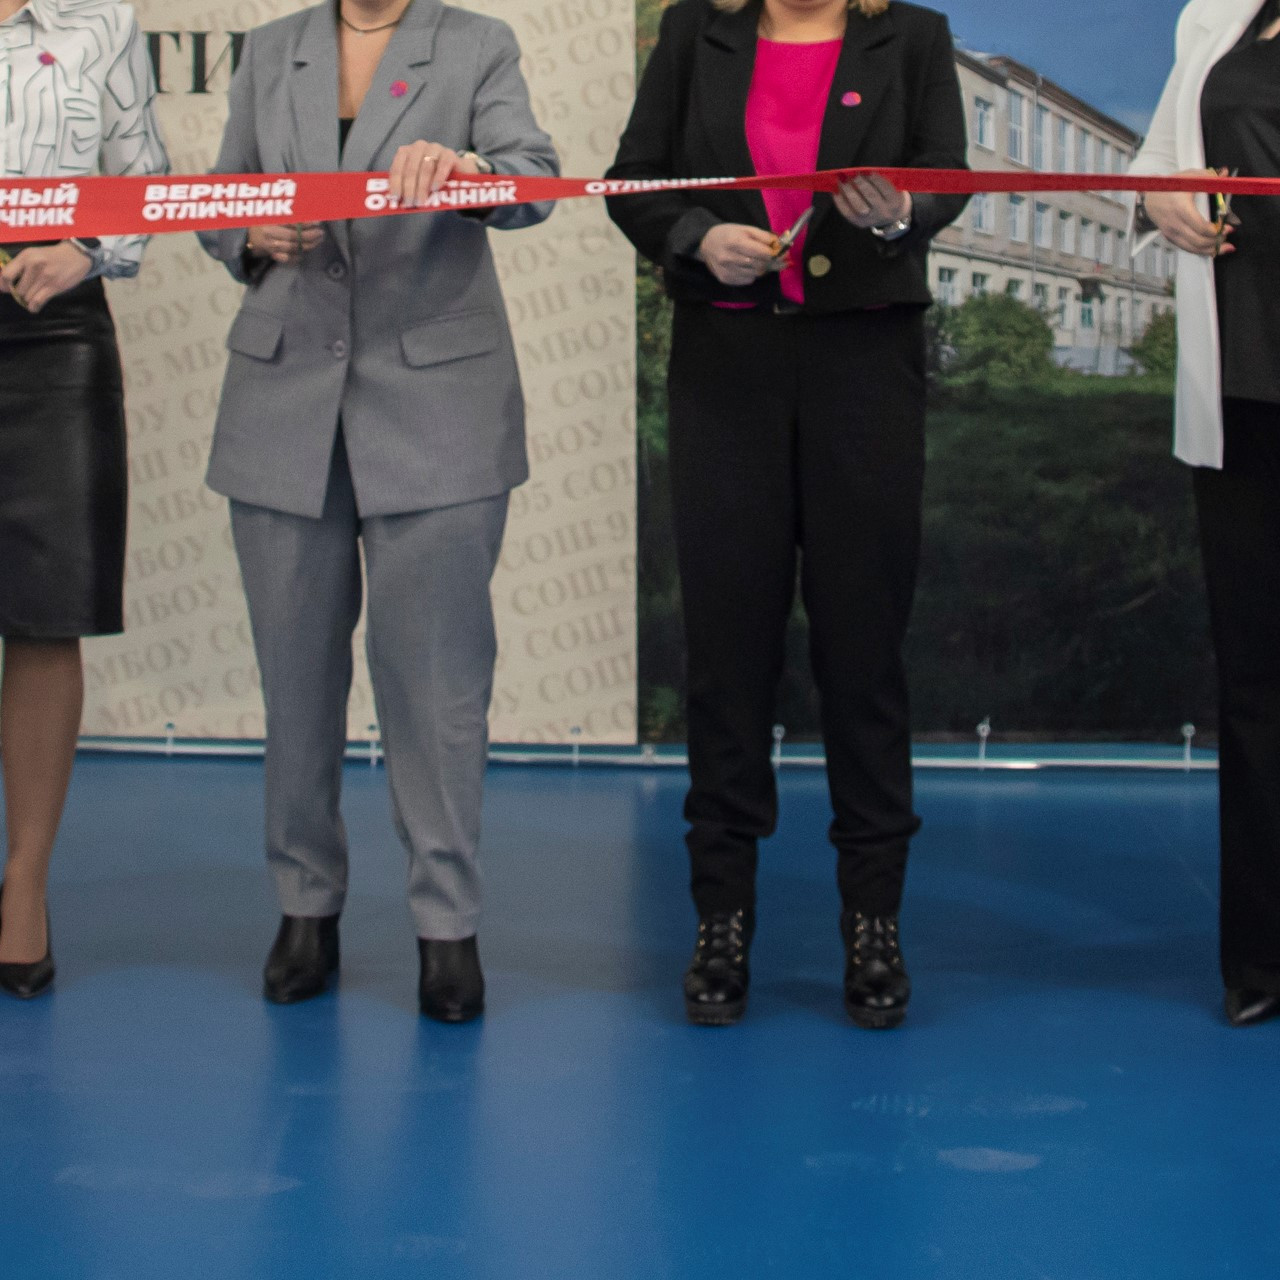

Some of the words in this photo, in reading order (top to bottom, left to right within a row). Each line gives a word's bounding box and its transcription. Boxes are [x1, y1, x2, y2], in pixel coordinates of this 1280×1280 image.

[141, 198, 295, 222] ОТЛИЧНИК
[143, 178, 297, 202] ВЕРНЫЙ
[579, 265, 625, 305] 95
[120, 295, 195, 345] БОУ
[131, 531, 210, 578] БОУ
[510, 563, 610, 617] СОШ
[524, 607, 625, 660] СОШ
